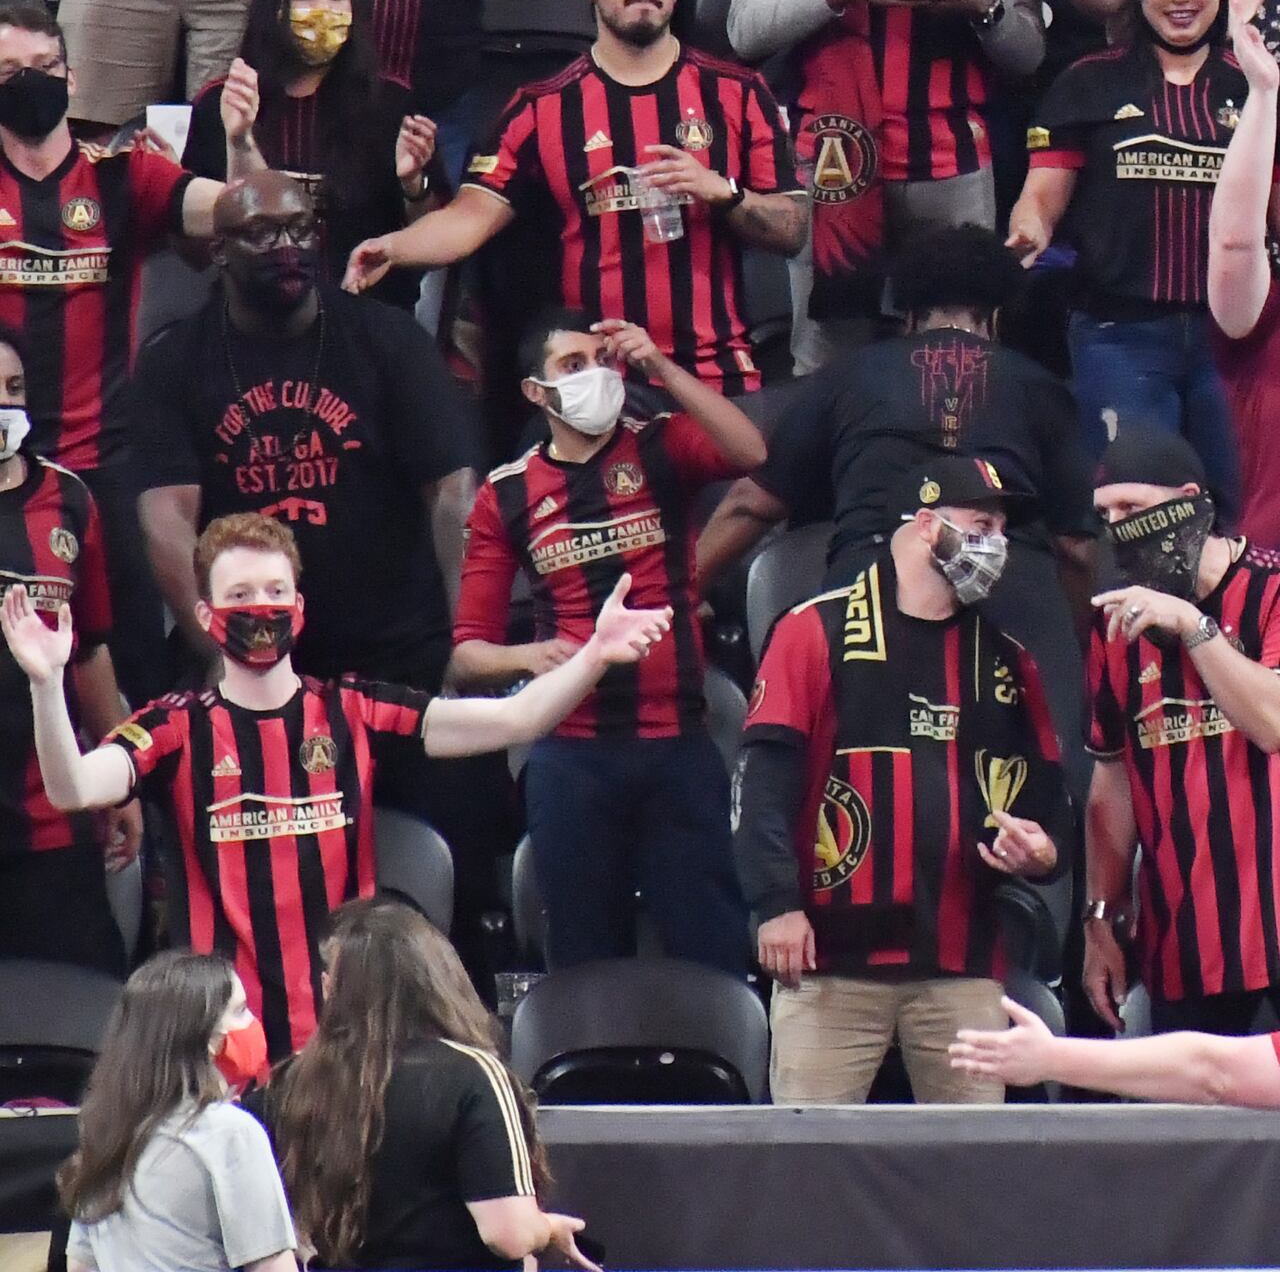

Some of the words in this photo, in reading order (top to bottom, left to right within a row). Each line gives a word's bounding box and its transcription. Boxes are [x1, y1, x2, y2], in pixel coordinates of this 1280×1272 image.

[1117, 150, 1193, 168] AMERICAN
[1126, 168, 1222, 180] INSURAN
[0, 257, 53, 272] ERICAN
[60, 254, 109, 271] FAMILY
[0, 270, 100, 284] SURANCE
[243, 382, 278, 416] THE
[281, 380, 357, 435] CULTURE
[287, 460, 340, 489] 2017
[1115, 512, 1169, 543] UNITED
[1168, 501, 1197, 526] FAN
[531, 531, 609, 564] AMERICAN
[608, 517, 662, 543] FAMILY
[209, 809, 288, 828] AMERICAN
[291, 800, 342, 821] FAMILY
[220, 818, 335, 839] INSURANCE
